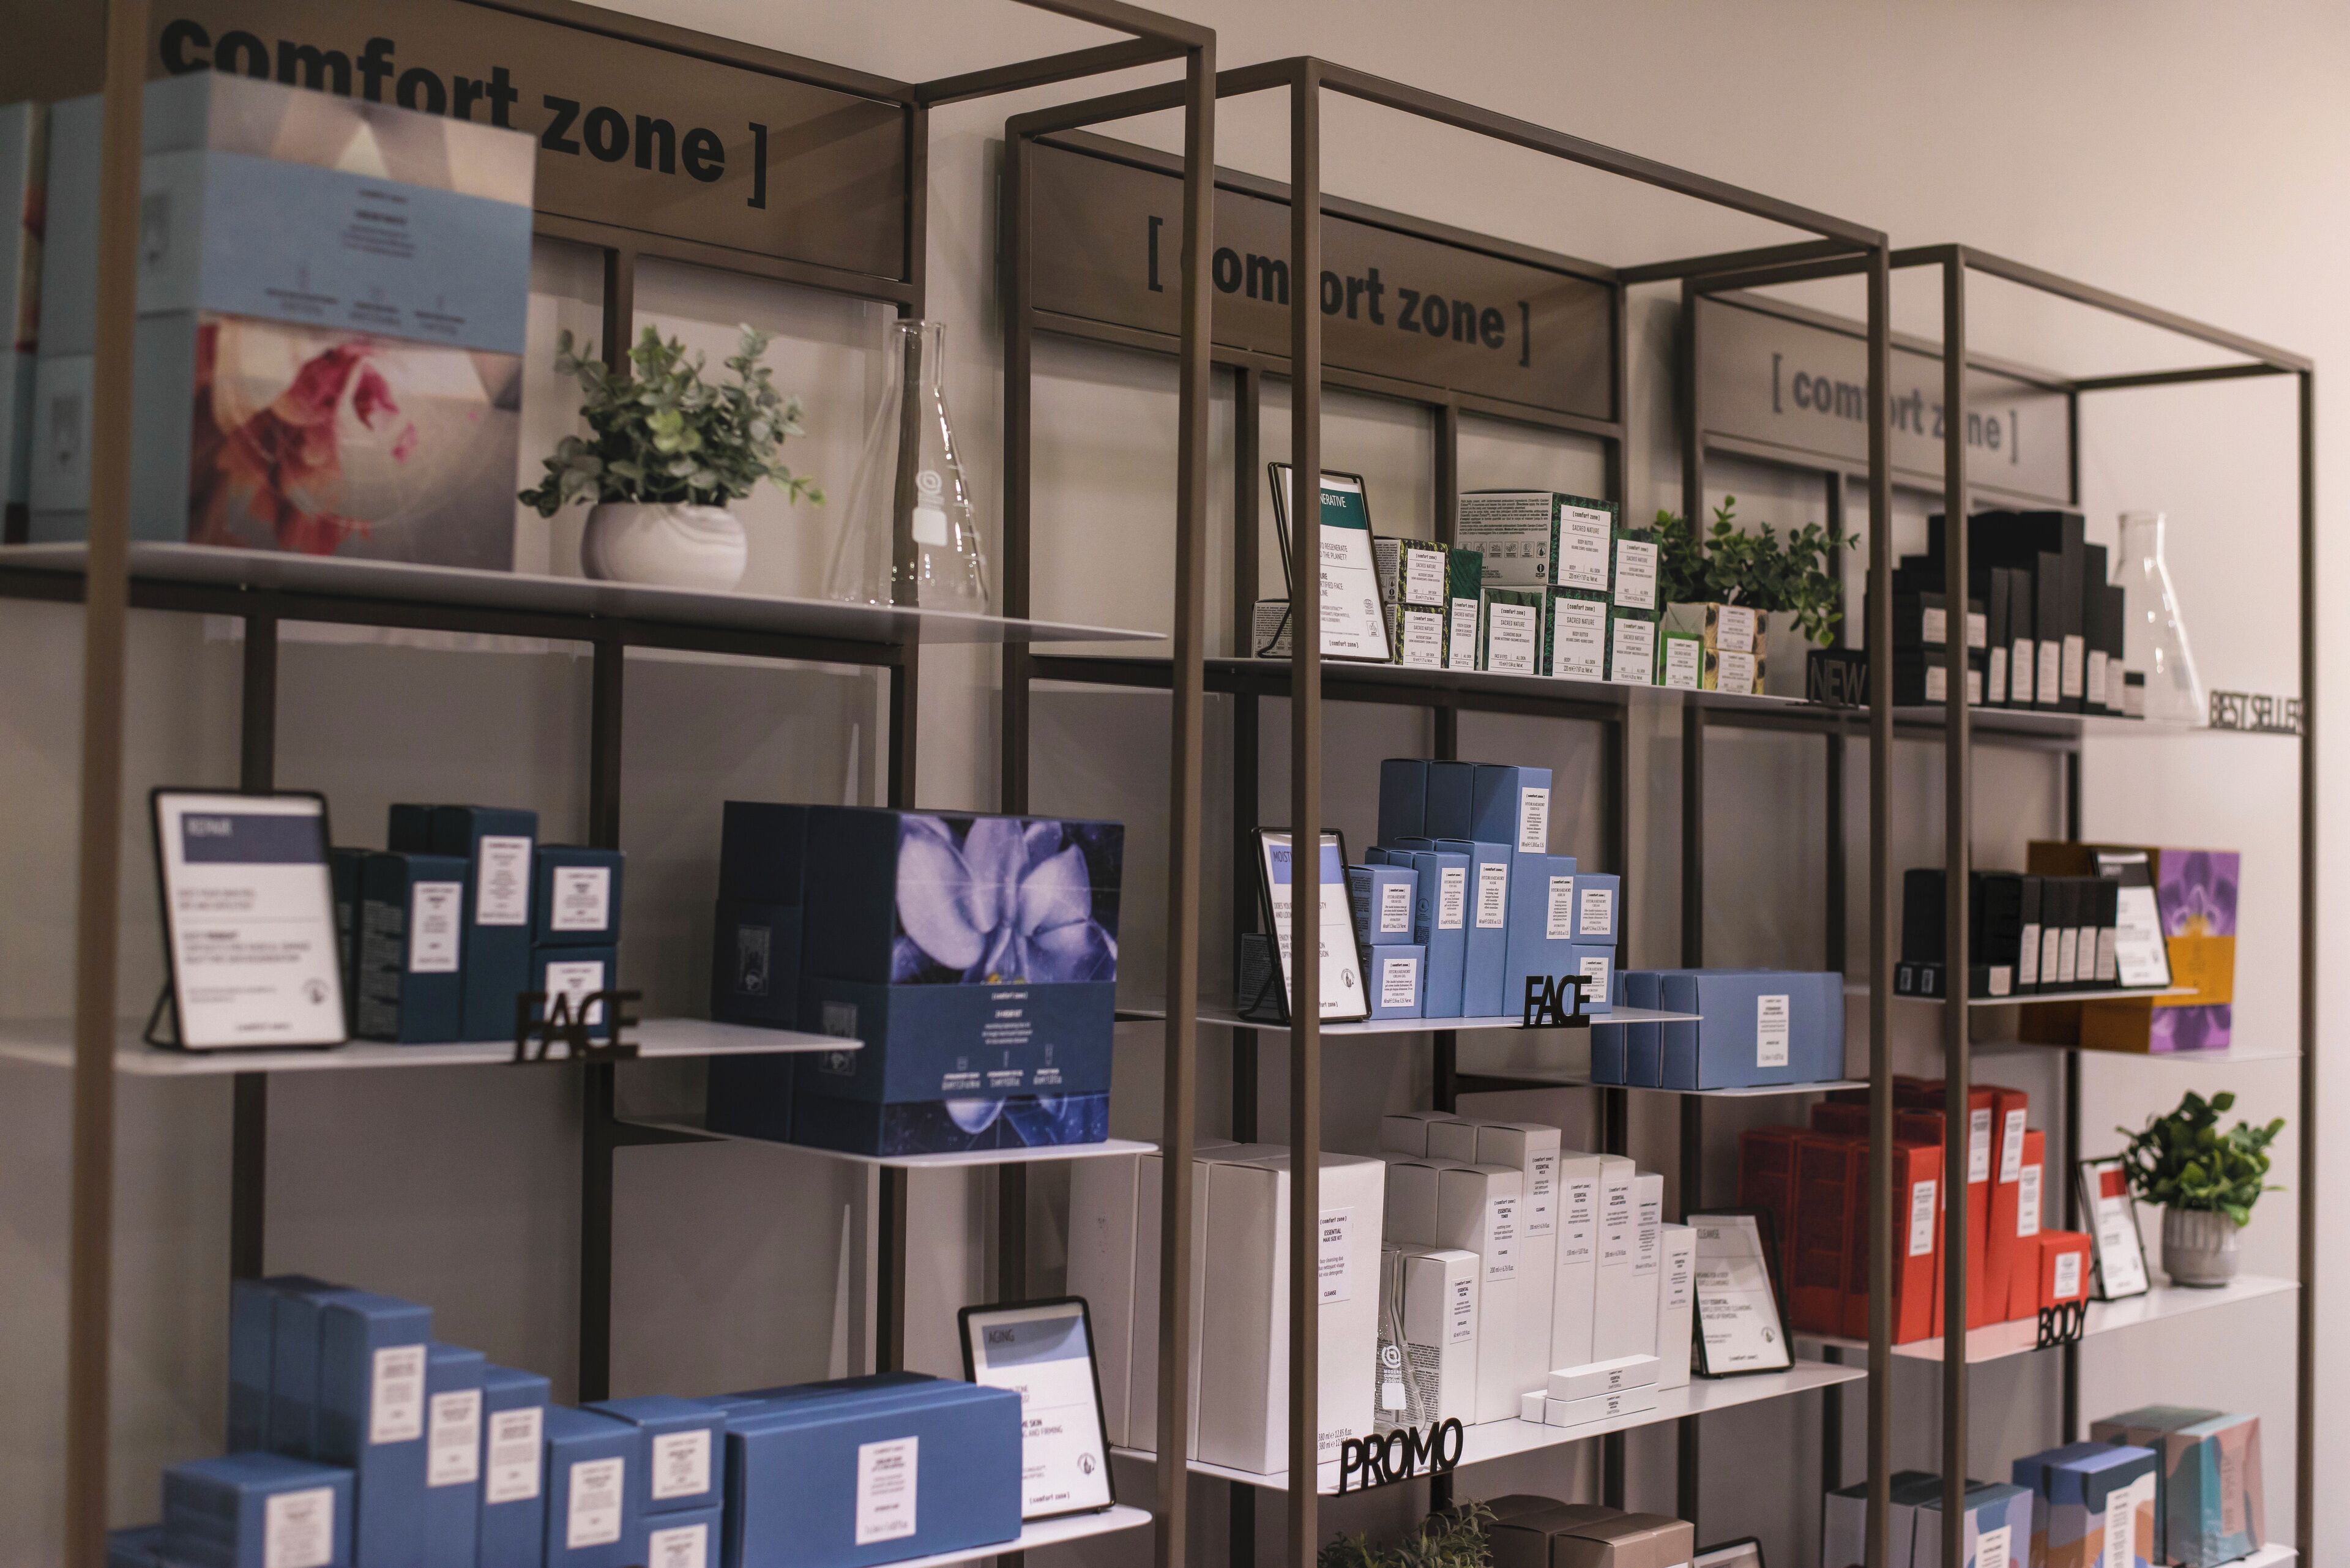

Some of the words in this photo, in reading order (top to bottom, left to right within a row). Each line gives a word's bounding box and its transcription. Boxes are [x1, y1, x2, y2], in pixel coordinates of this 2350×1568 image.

[540, 93, 726, 184] zone
[1181, 246, 1384, 326] omort
[1398, 287, 1505, 349] zone
[1792, 370, 1925, 436] comrt
[1930, 403, 2002, 452] zne
[1320, 493, 1346, 507] NERATIVE
[1325, 543, 1348, 552] REGENERATE
[1809, 656, 1867, 711] NEW
[513, 990, 641, 1064] FACE
[1523, 975, 1592, 1028] FACE
[988, 1329, 1015, 1344] AGING
[2034, 1296, 2092, 1351] BODY
[1041, 1425, 1063, 1436] FIRMING
[1339, 1417, 1464, 1497] PROMO
